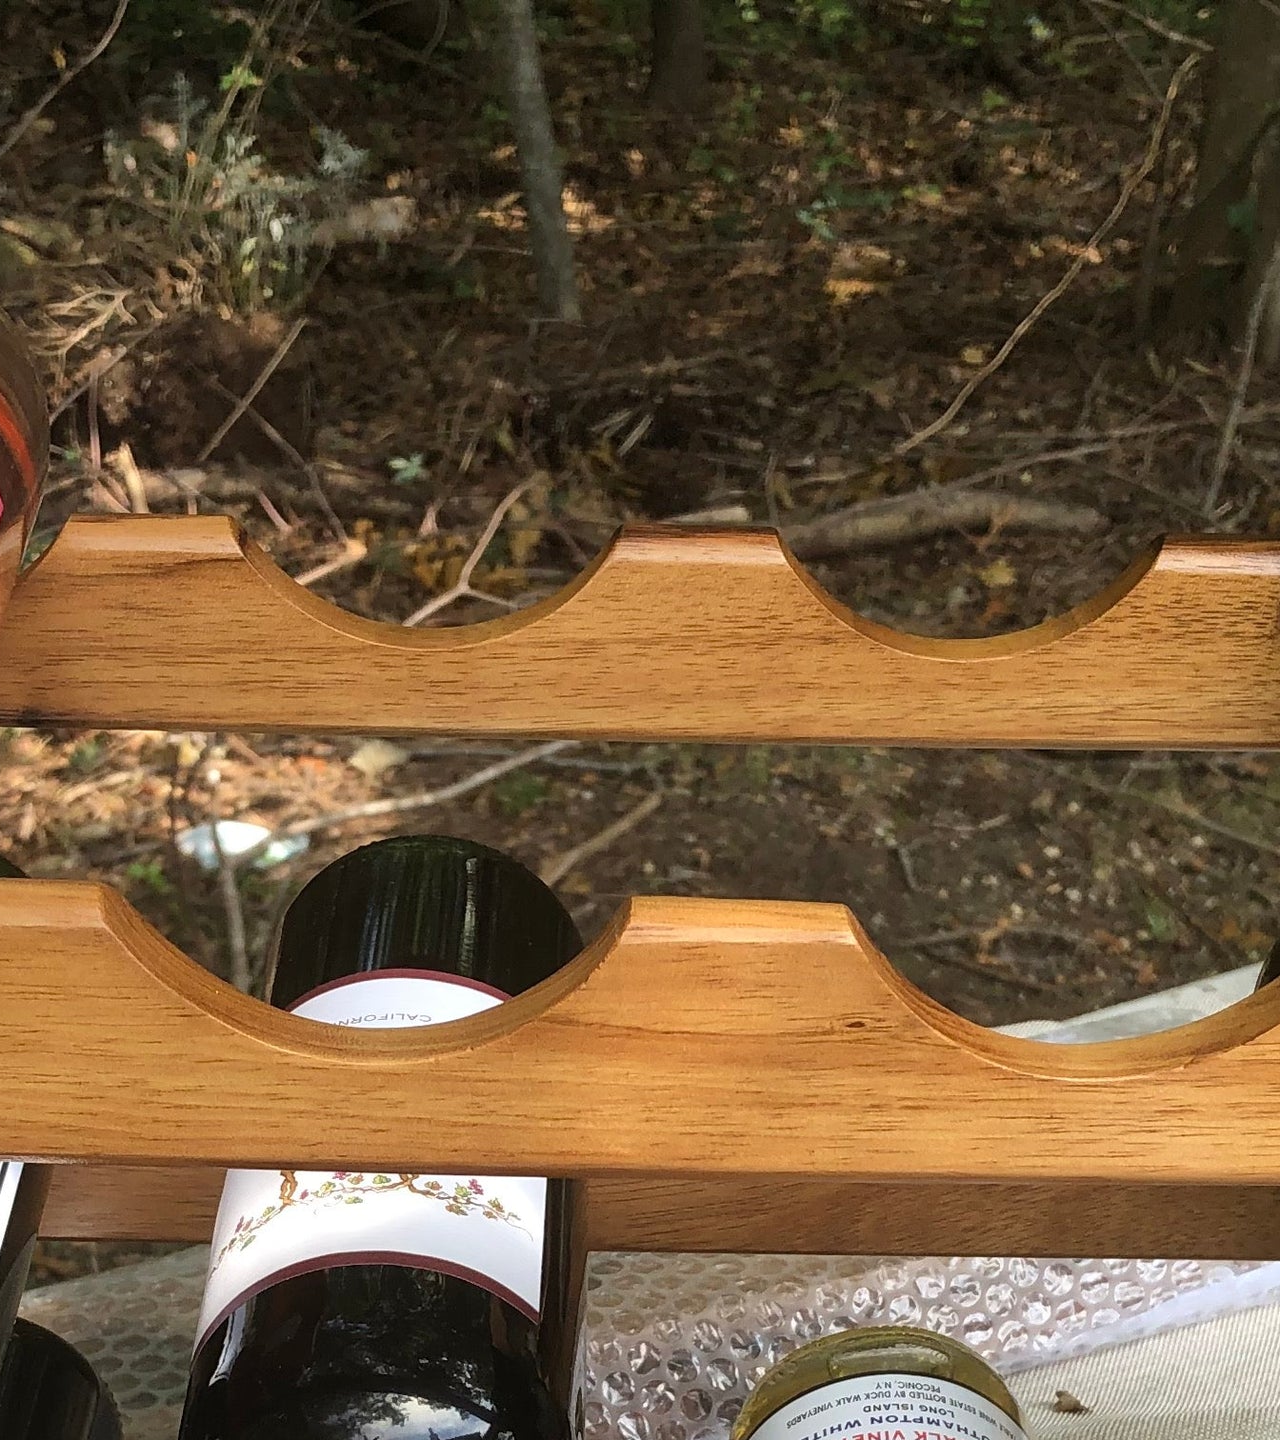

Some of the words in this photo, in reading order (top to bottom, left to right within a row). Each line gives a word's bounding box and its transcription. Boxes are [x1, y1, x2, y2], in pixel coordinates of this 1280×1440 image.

[333, 1012, 432, 1027] CALIFORN
[894, 1381, 941, 1394] PECONIC,
[835, 1393, 861, 1407] WALK
[863, 1390, 892, 1401] DUCK
[893, 1390, 906, 1399] BY
[908, 1390, 947, 1404] BOTTLED
[862, 1403, 914, 1414] ISLAND
[917, 1405, 955, 1418] LONG
[949, 1397, 976, 1415] ESTATE
[784, 1401, 833, 1430] VINEYARDS
